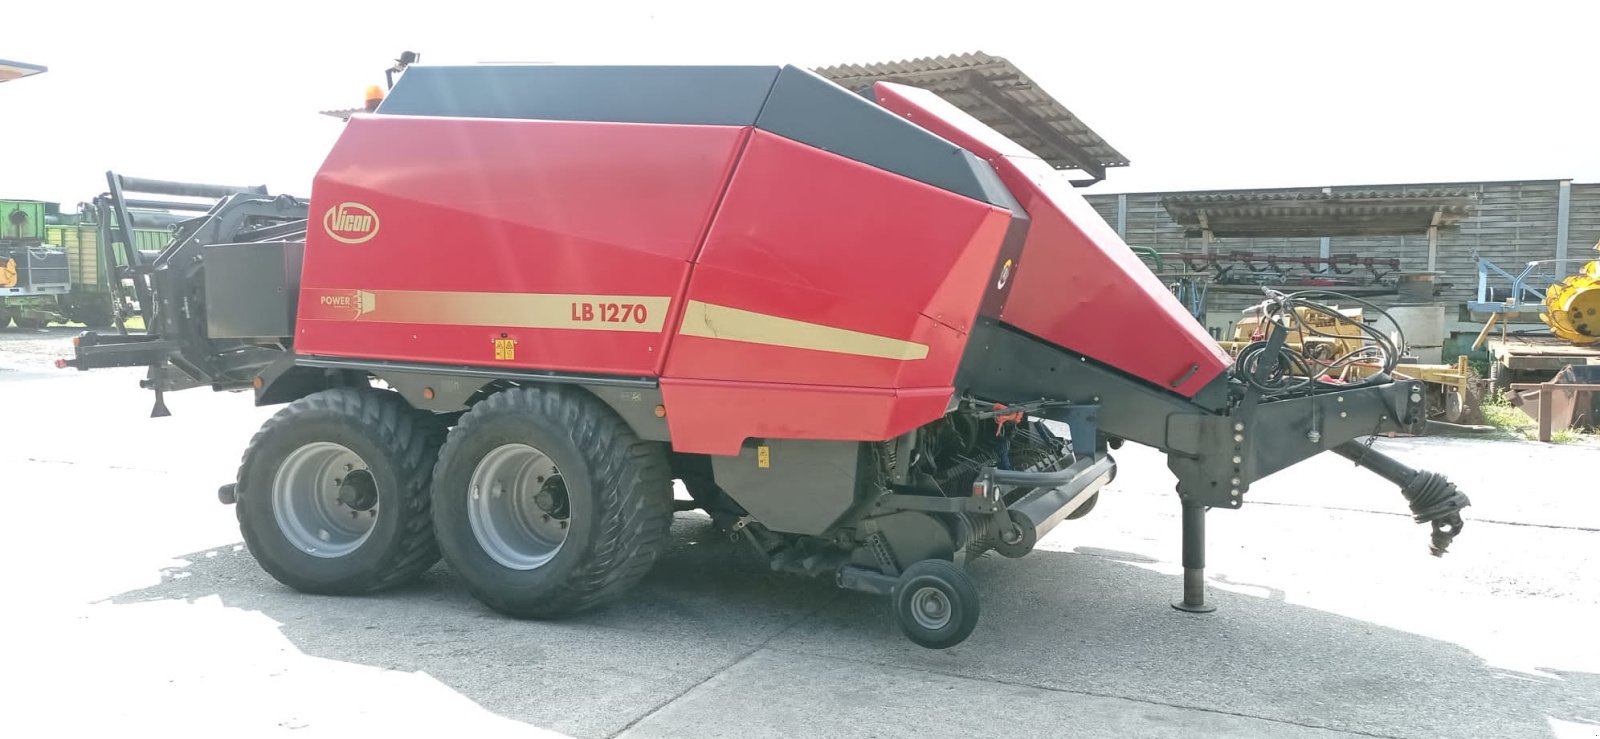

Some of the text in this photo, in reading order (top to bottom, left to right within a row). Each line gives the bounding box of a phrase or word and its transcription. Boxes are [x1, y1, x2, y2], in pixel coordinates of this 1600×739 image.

[332, 205, 372, 232] Vicon
[320, 296, 350, 305] POWER
[571, 303, 648, 324] LB 1270
